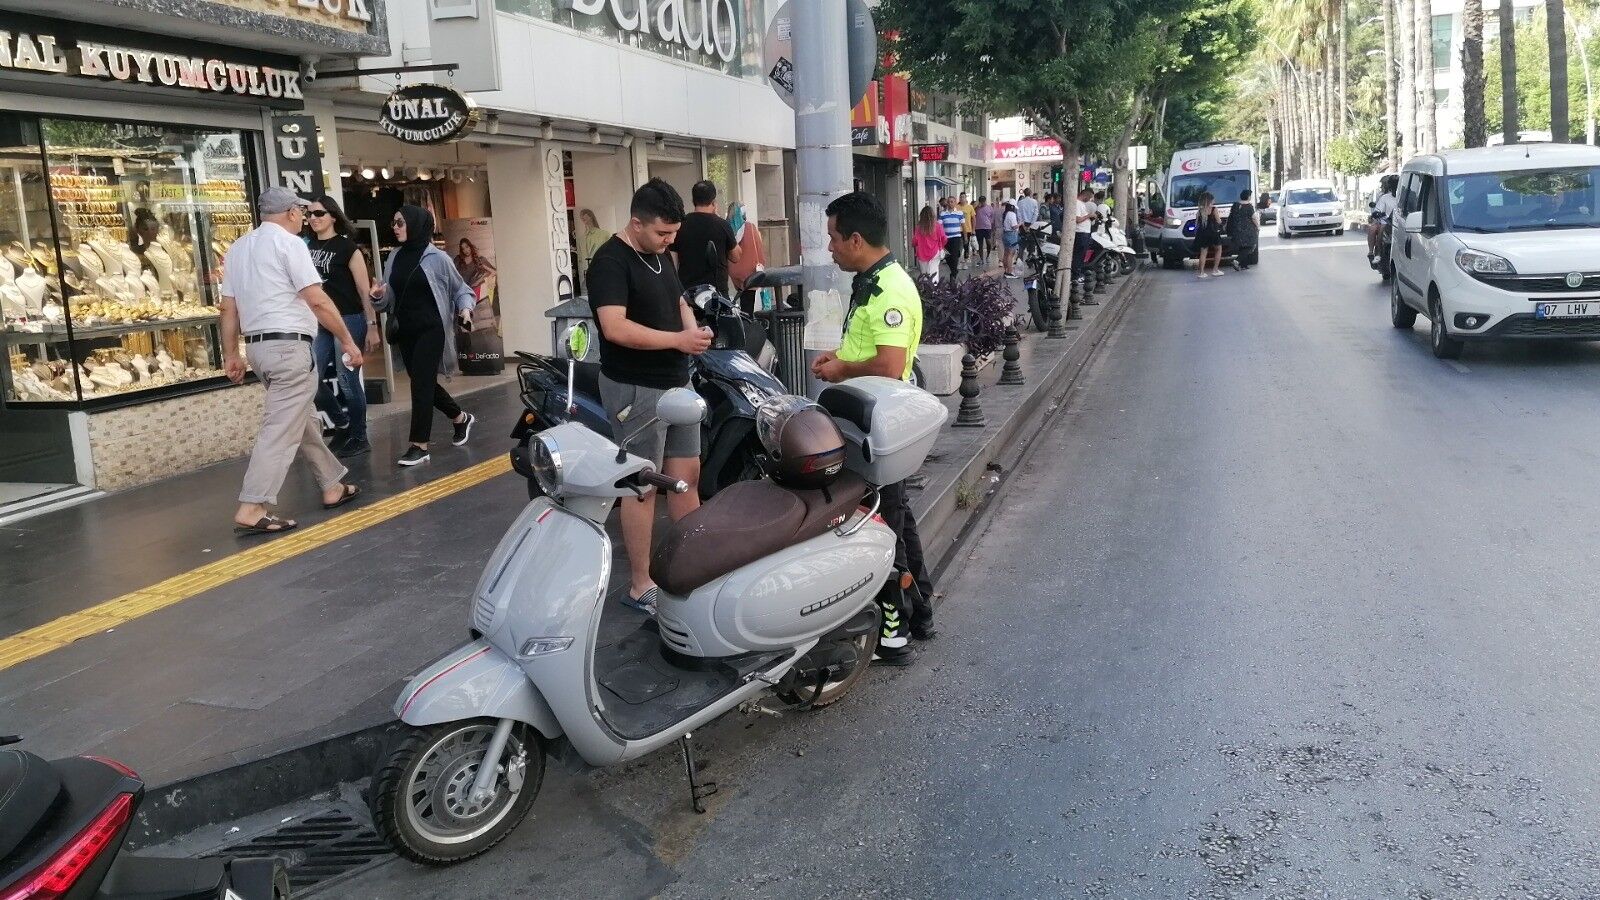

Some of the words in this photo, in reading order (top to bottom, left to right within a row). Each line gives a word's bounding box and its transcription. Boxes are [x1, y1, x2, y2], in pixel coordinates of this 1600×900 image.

[76, 39, 304, 100] KUYUMCULUK
[388, 94, 449, 121] ÜNAL
[378, 111, 463, 143] KUYUMCULUK
[1001, 144, 1060, 159] vodafone
[1544, 305, 1558, 316] 07
[1567, 304, 1588, 315] LHV
[827, 513, 846, 528] JPN
